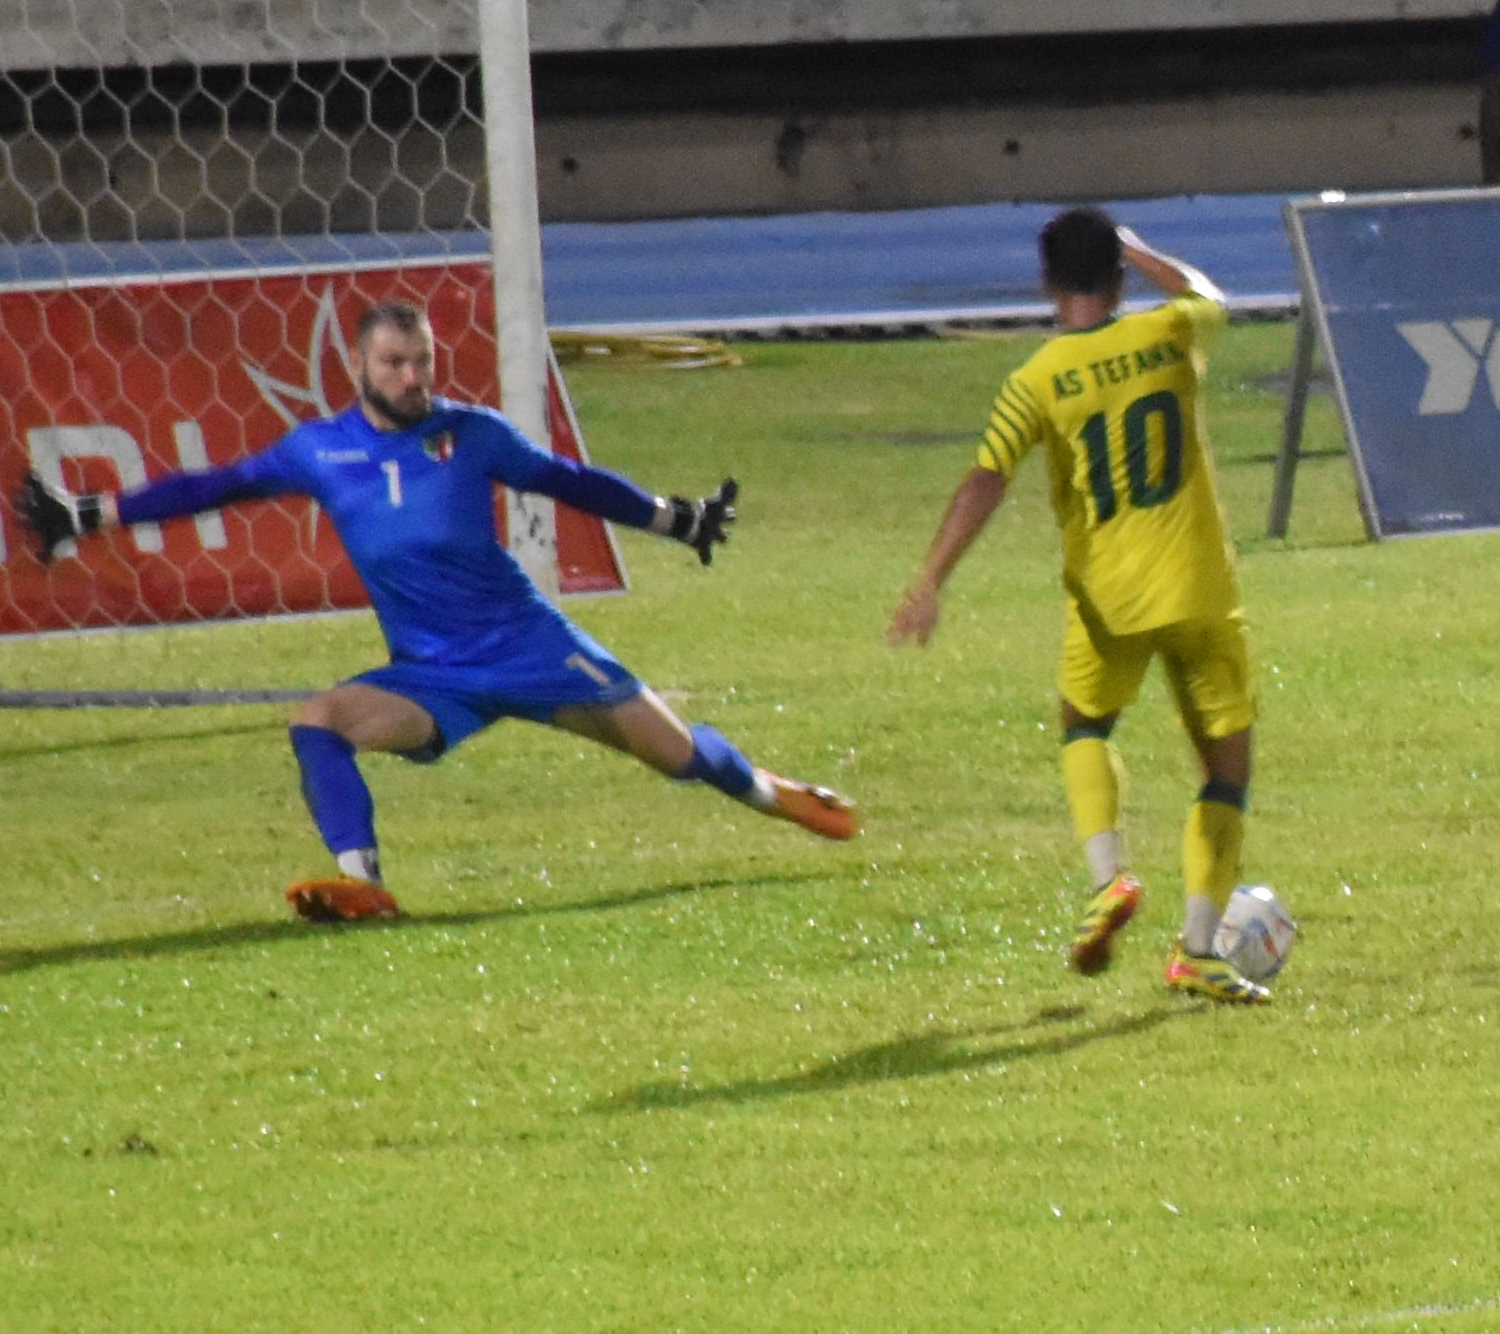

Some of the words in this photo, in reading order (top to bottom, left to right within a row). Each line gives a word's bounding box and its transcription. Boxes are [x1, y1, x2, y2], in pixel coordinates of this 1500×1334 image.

[1052, 369, 1085, 401] AS
[1078, 390, 1182, 523] 10
[380, 460, 403, 508] 1
